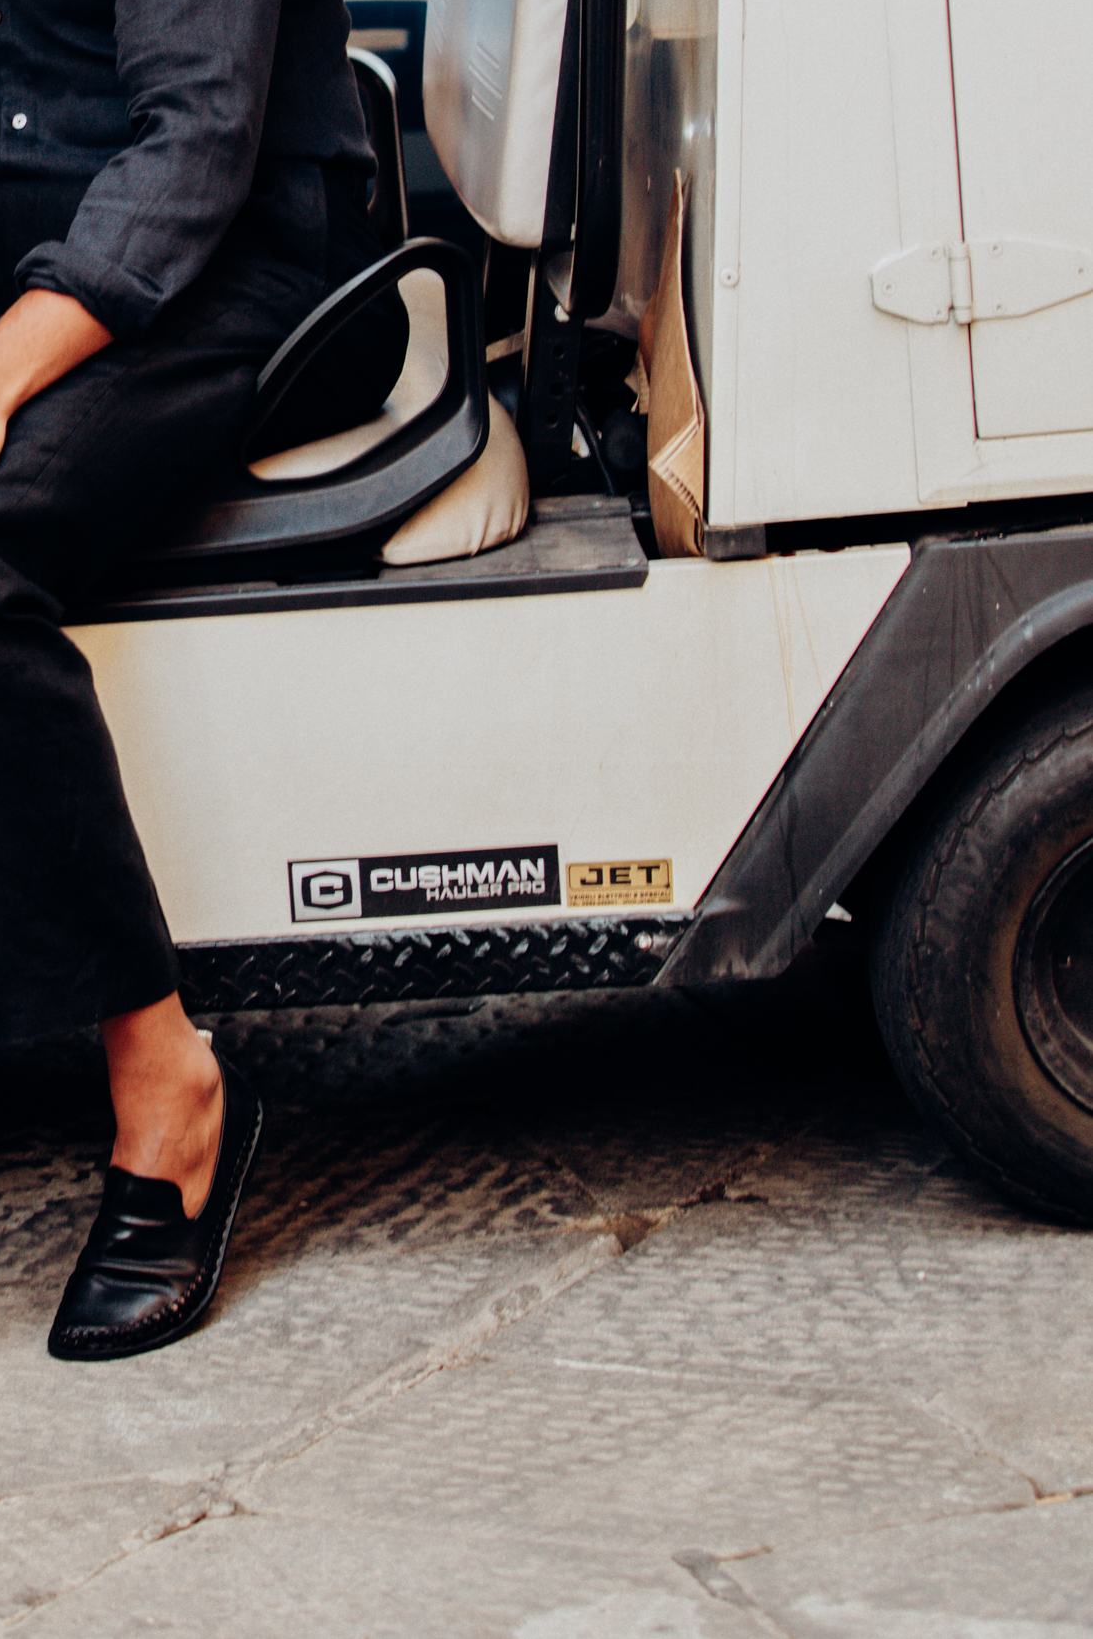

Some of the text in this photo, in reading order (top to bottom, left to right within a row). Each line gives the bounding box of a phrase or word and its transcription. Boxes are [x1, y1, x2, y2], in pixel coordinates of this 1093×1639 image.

[370, 857, 546, 893] CUSHMAN
[580, 865, 661, 886] JET
[426, 879, 546, 902] HAULER PRO
